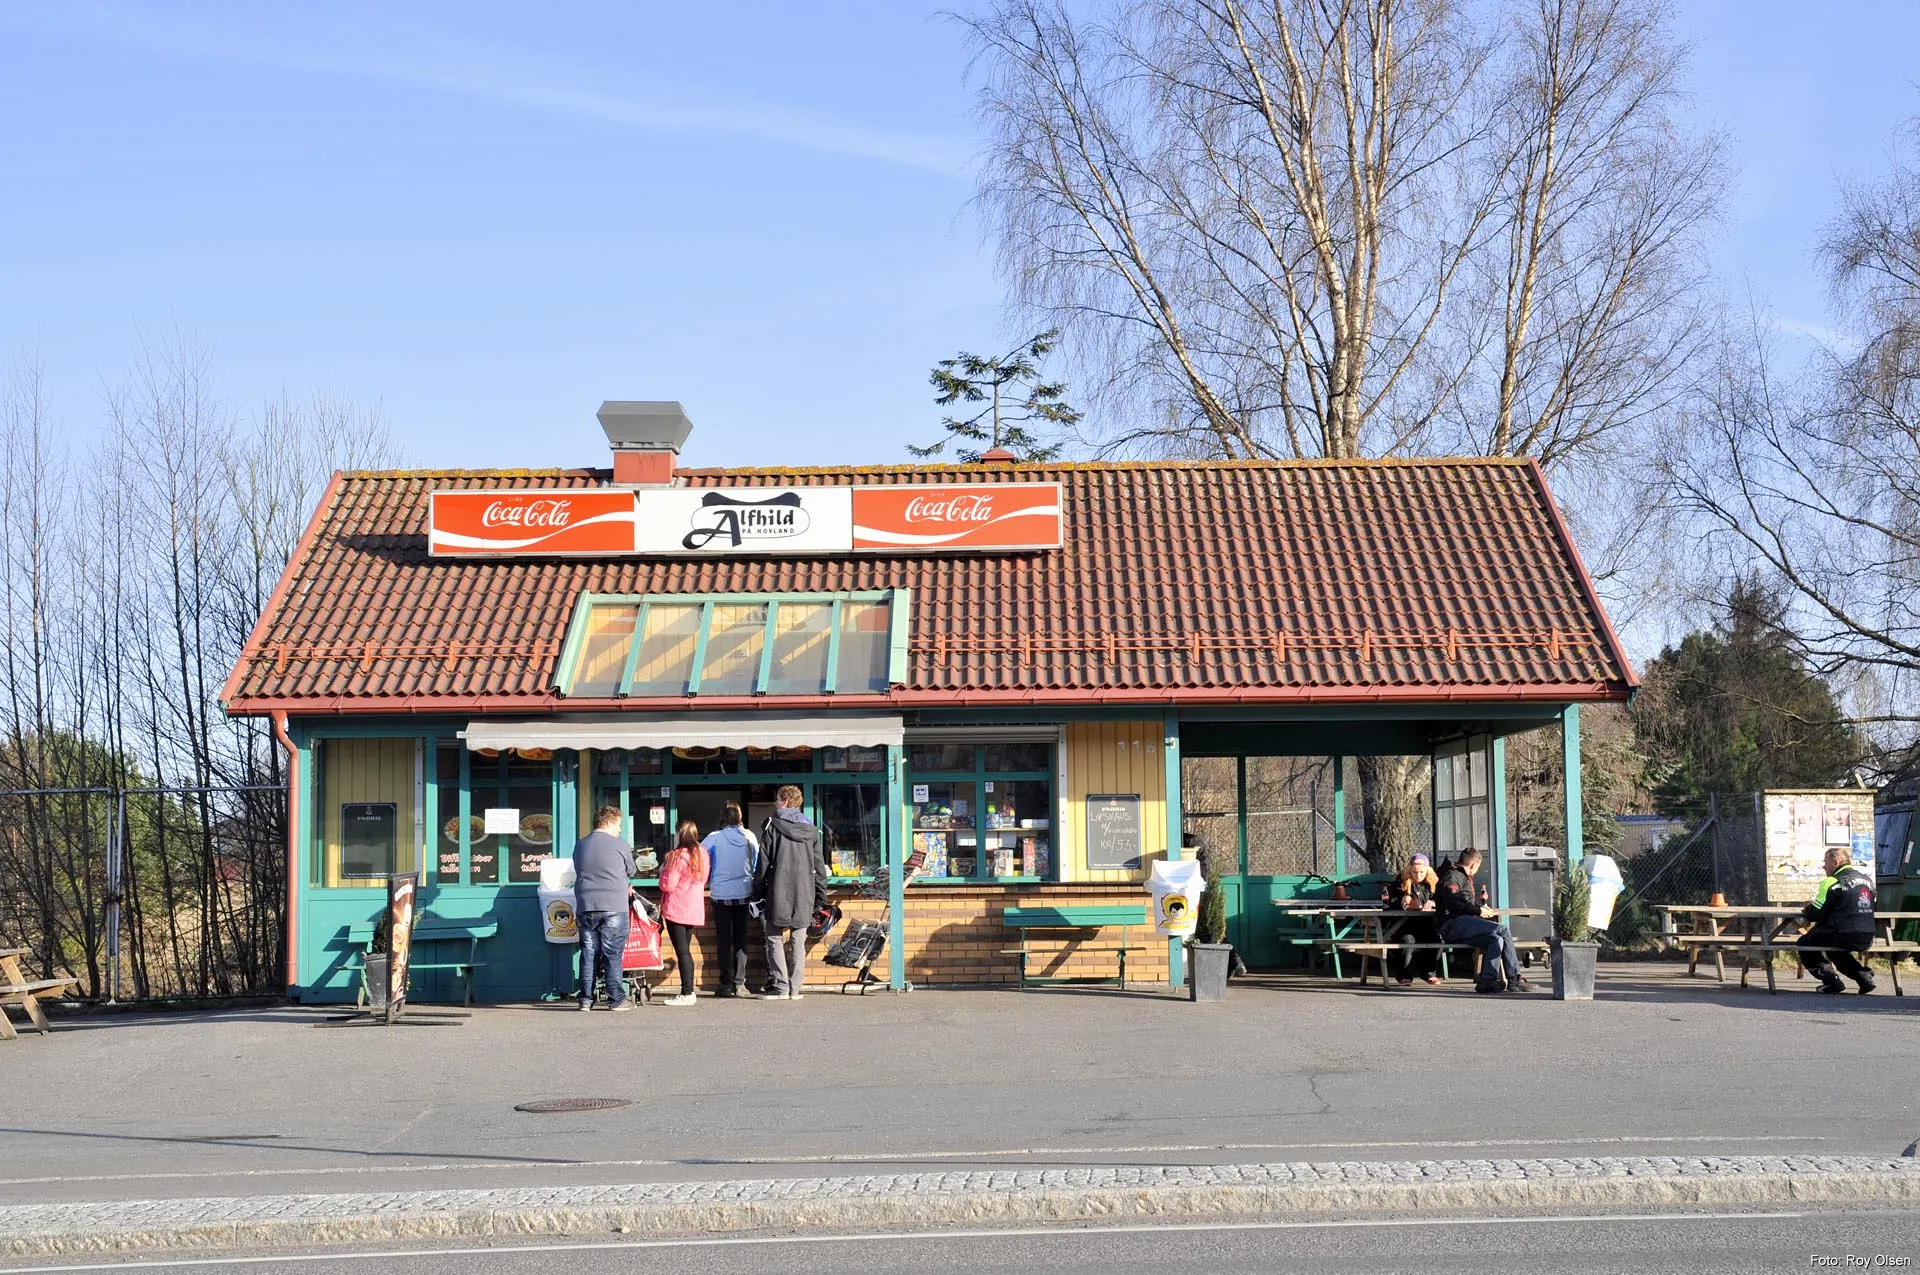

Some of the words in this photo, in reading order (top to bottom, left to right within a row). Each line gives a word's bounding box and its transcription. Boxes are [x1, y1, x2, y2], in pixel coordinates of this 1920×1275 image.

[482, 500, 572, 527] Coca-Cola
[905, 494, 994, 522] Coca-Cola
[682, 509, 794, 549] Alfhild
